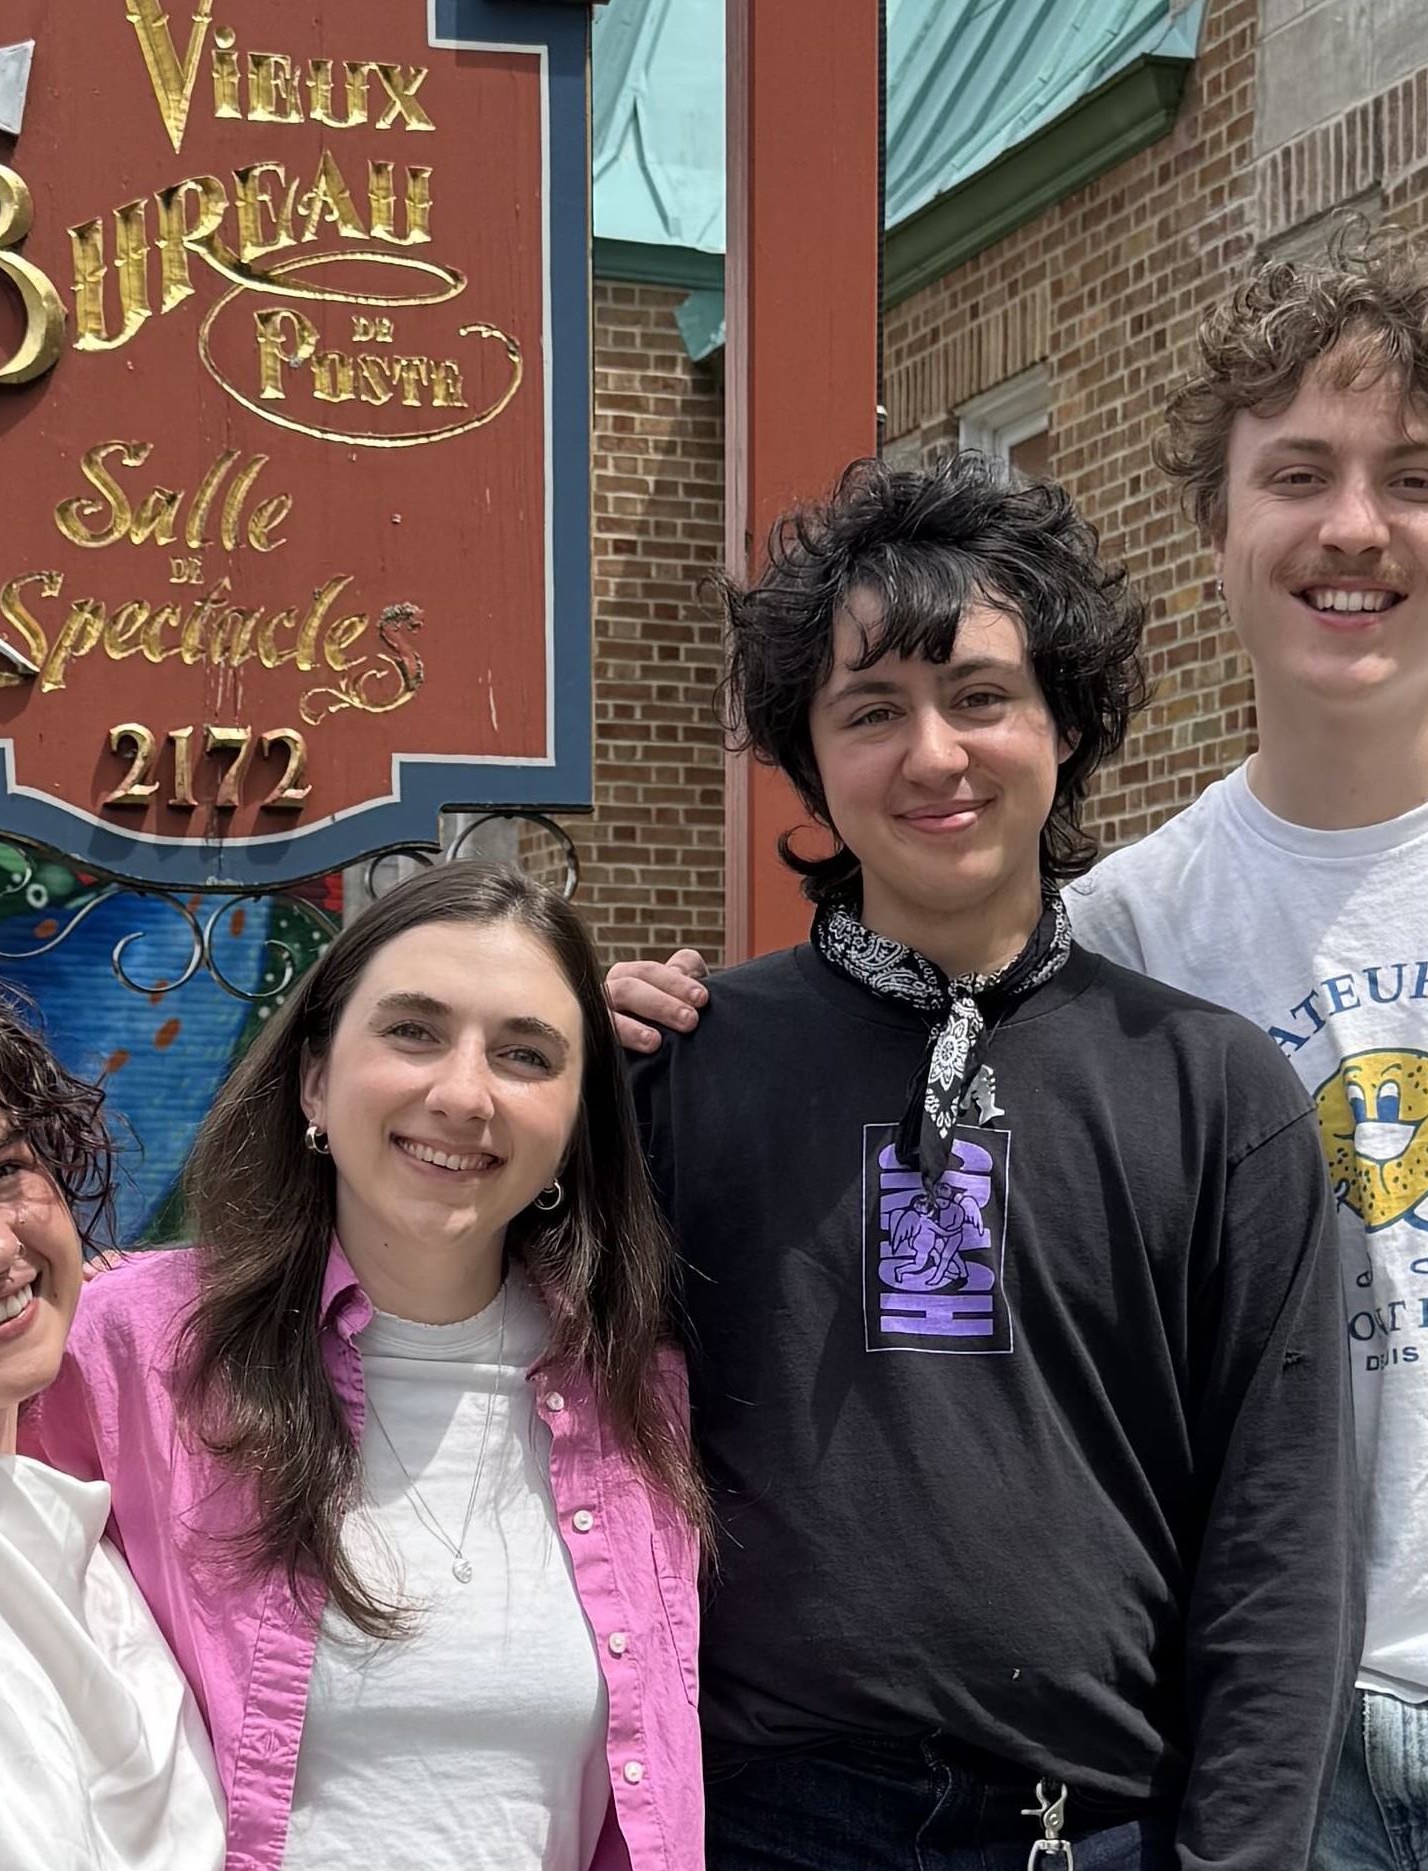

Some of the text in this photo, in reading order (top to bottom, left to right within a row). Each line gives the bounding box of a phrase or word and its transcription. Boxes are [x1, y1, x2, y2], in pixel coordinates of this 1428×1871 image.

[253, 307, 469, 409] POSTE
[351, 315, 395, 343] DE
[54, 438, 293, 553] Salle
[169, 555, 204, 584] DE
[102, 722, 313, 807] 2172
